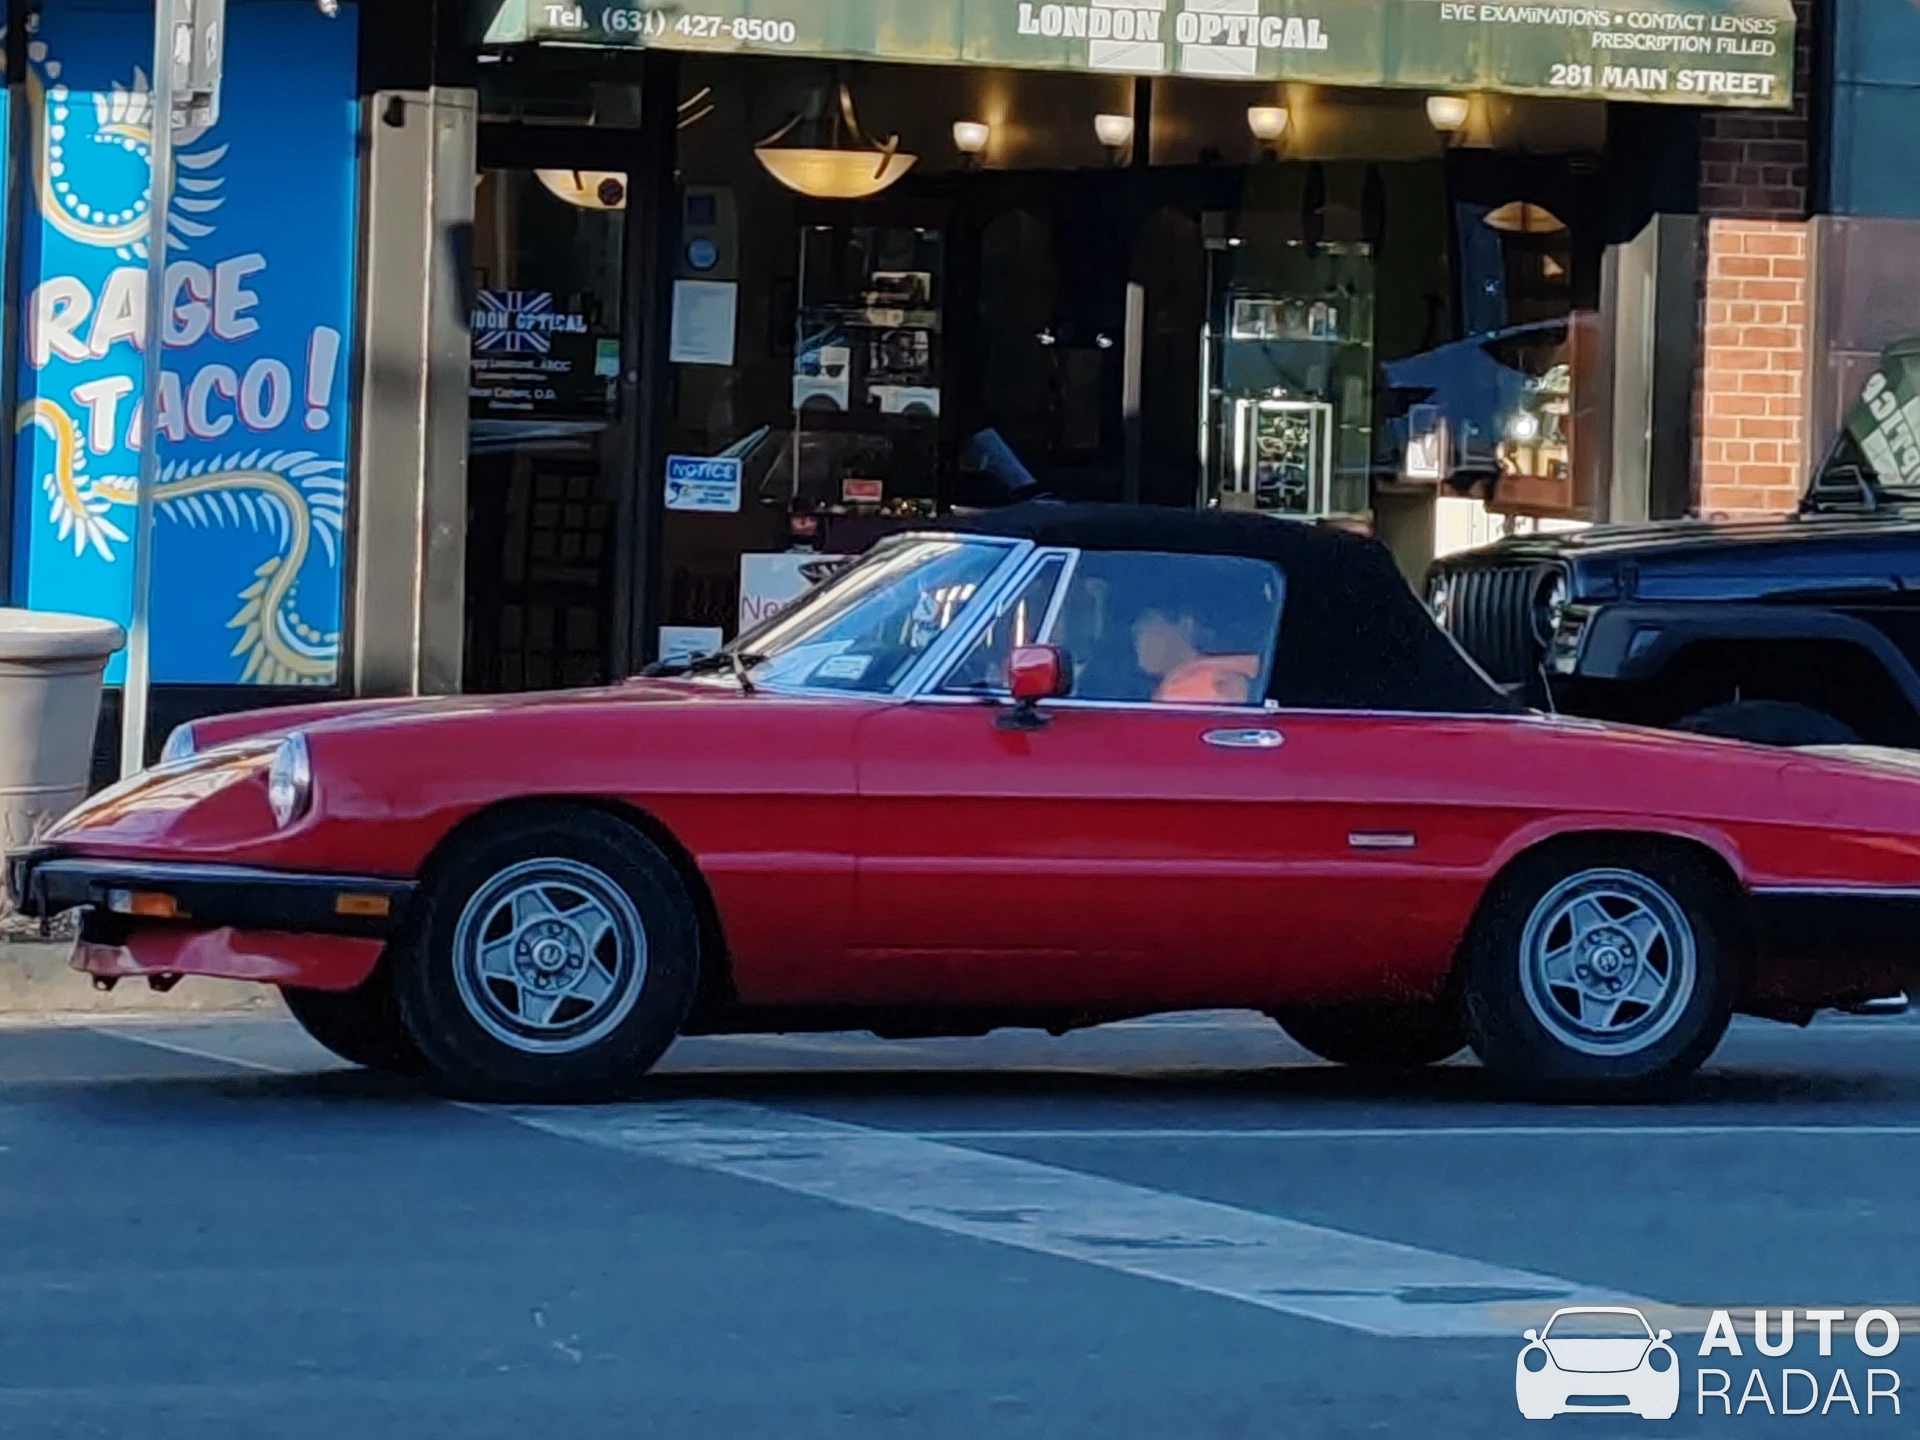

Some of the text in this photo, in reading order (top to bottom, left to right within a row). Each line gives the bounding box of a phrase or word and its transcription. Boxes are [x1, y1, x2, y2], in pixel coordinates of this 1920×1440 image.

[544, 4, 796, 43] Tel. (631) 427-8500
[1017, 3, 1328, 50] LONDON OPTICAL
[1440, 3, 1776, 35] EYE EXAMINATIONS CONTACT LENSES
[1591, 31, 1776, 56] PRESCRIPTION FILLED
[1549, 63, 1776, 95] 281 MAIN STREET
[27, 253, 267, 368] RAGE
[672, 463, 734, 478] NOTICE
